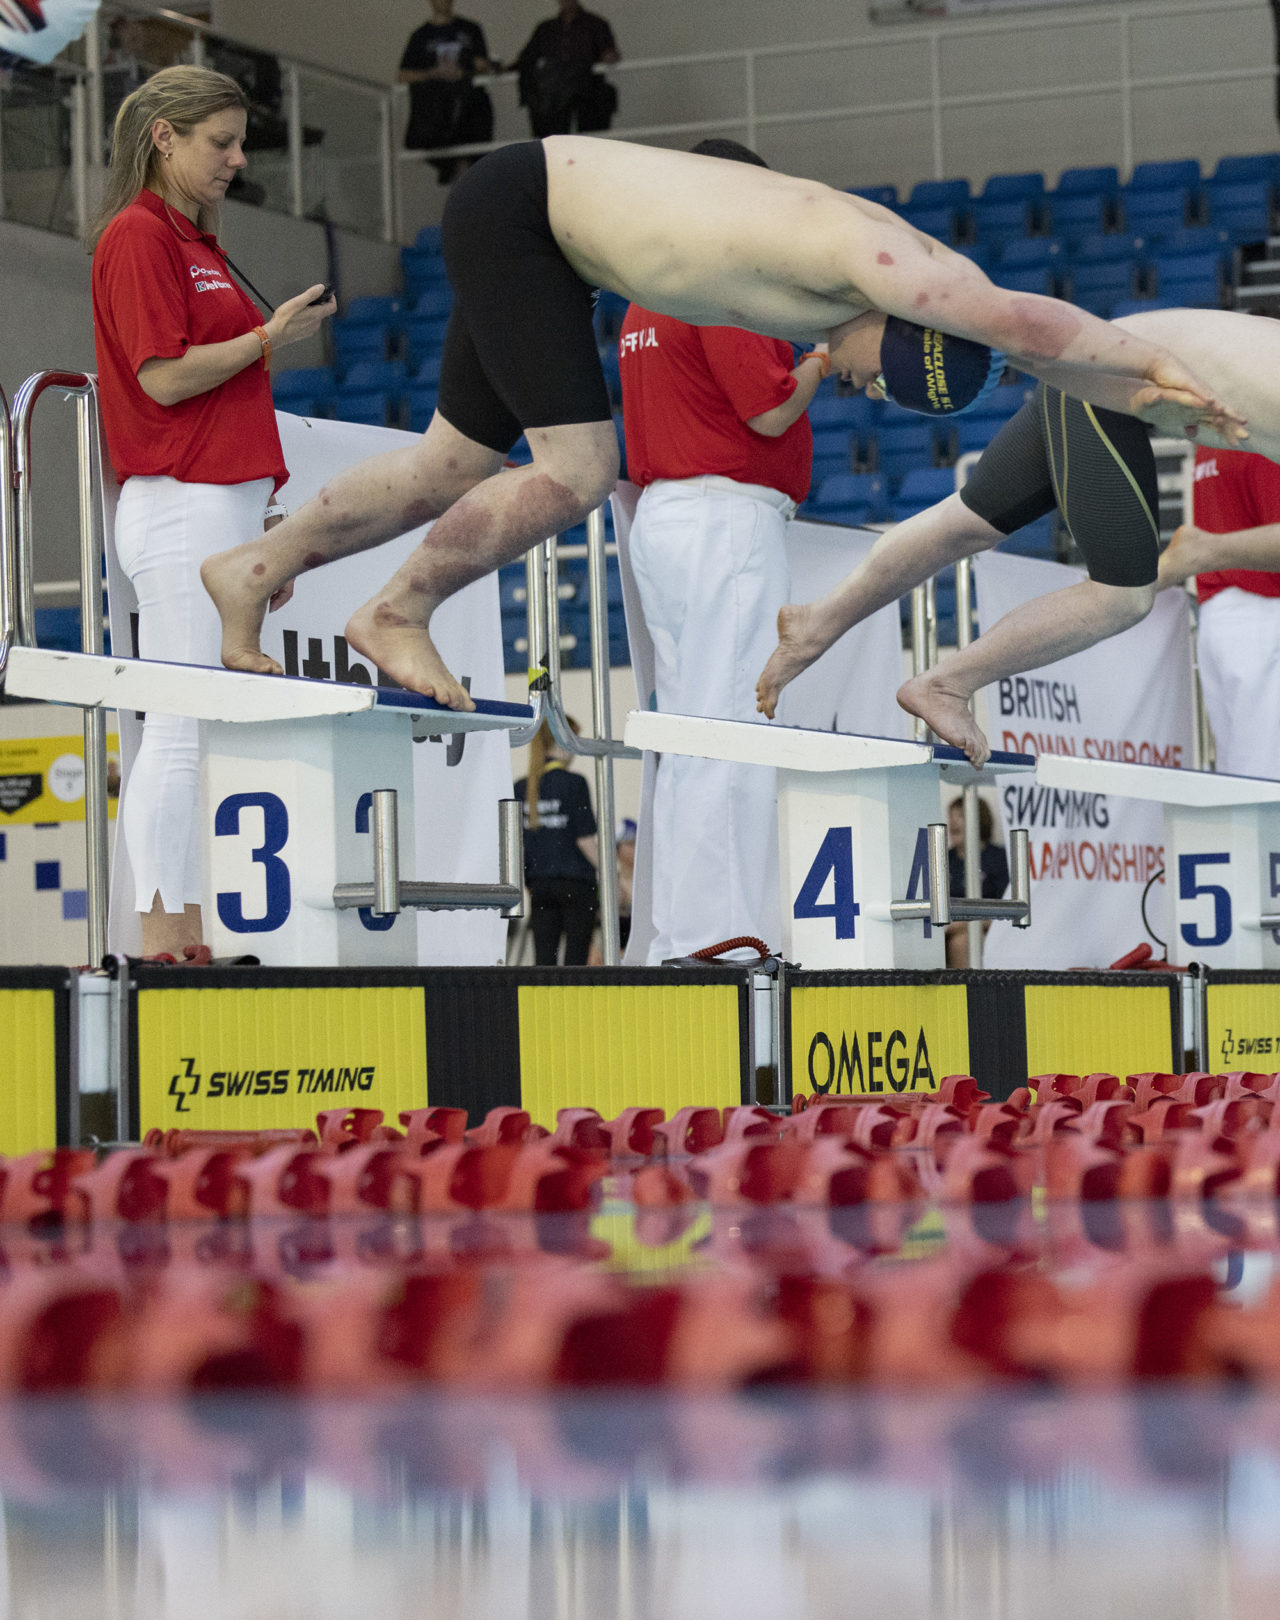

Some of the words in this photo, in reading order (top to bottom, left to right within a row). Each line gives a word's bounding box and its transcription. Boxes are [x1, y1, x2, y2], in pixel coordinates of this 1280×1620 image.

[1000, 678, 1081, 723] BRITISH
[215, 792, 291, 933] 3
[794, 826, 860, 939] 4
[1179, 852, 1232, 947] 5
[206, 1069, 291, 1097] SWISS
[296, 1066, 376, 1094] TIMING
[808, 1024, 936, 1096] OMEGA
[1237, 1038, 1272, 1055] SWISS
